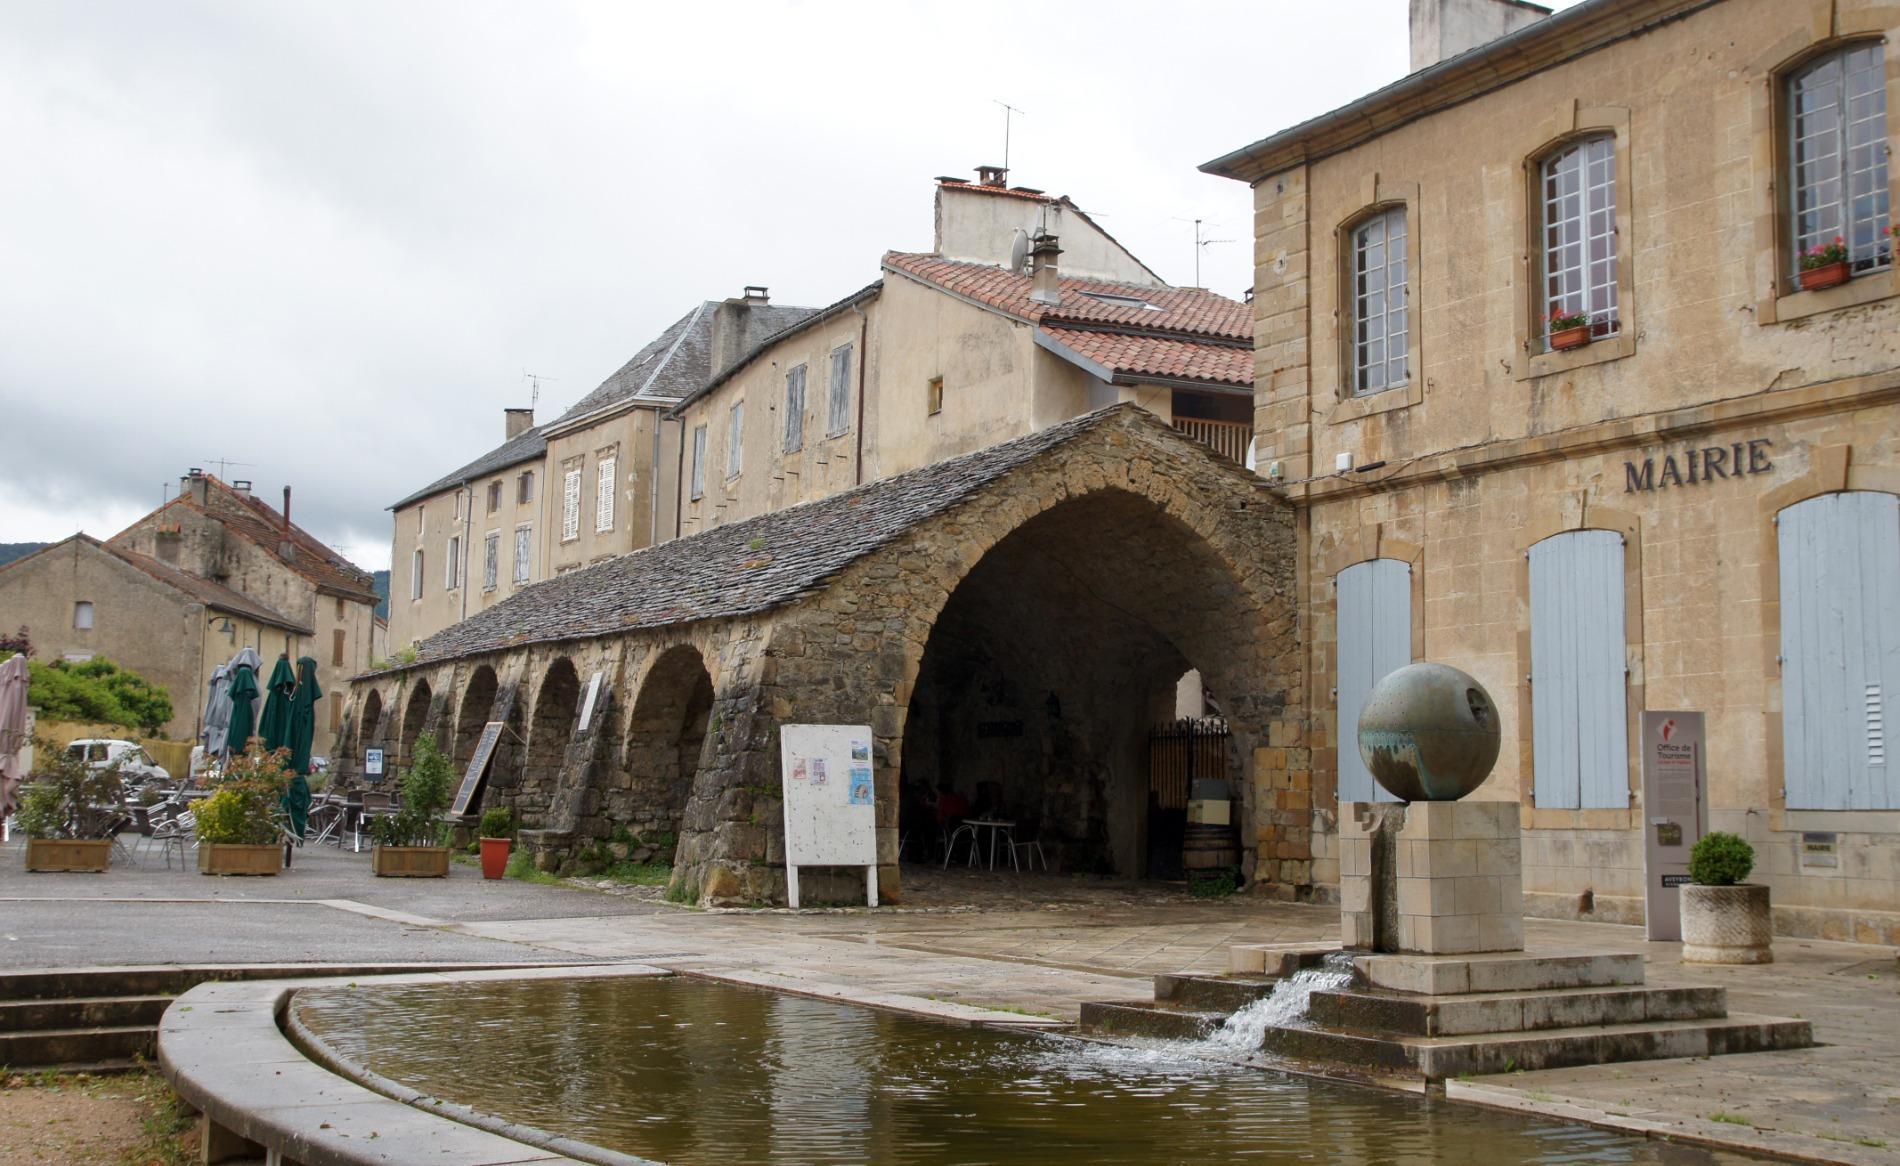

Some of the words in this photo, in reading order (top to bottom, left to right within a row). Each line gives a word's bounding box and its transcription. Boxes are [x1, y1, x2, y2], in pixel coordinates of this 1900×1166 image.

[1624, 438, 1773, 493] MAIRIE
[1657, 743, 1680, 752] Office
[1681, 743, 1692, 752] de
[1657, 751, 1692, 760] Tourisme
